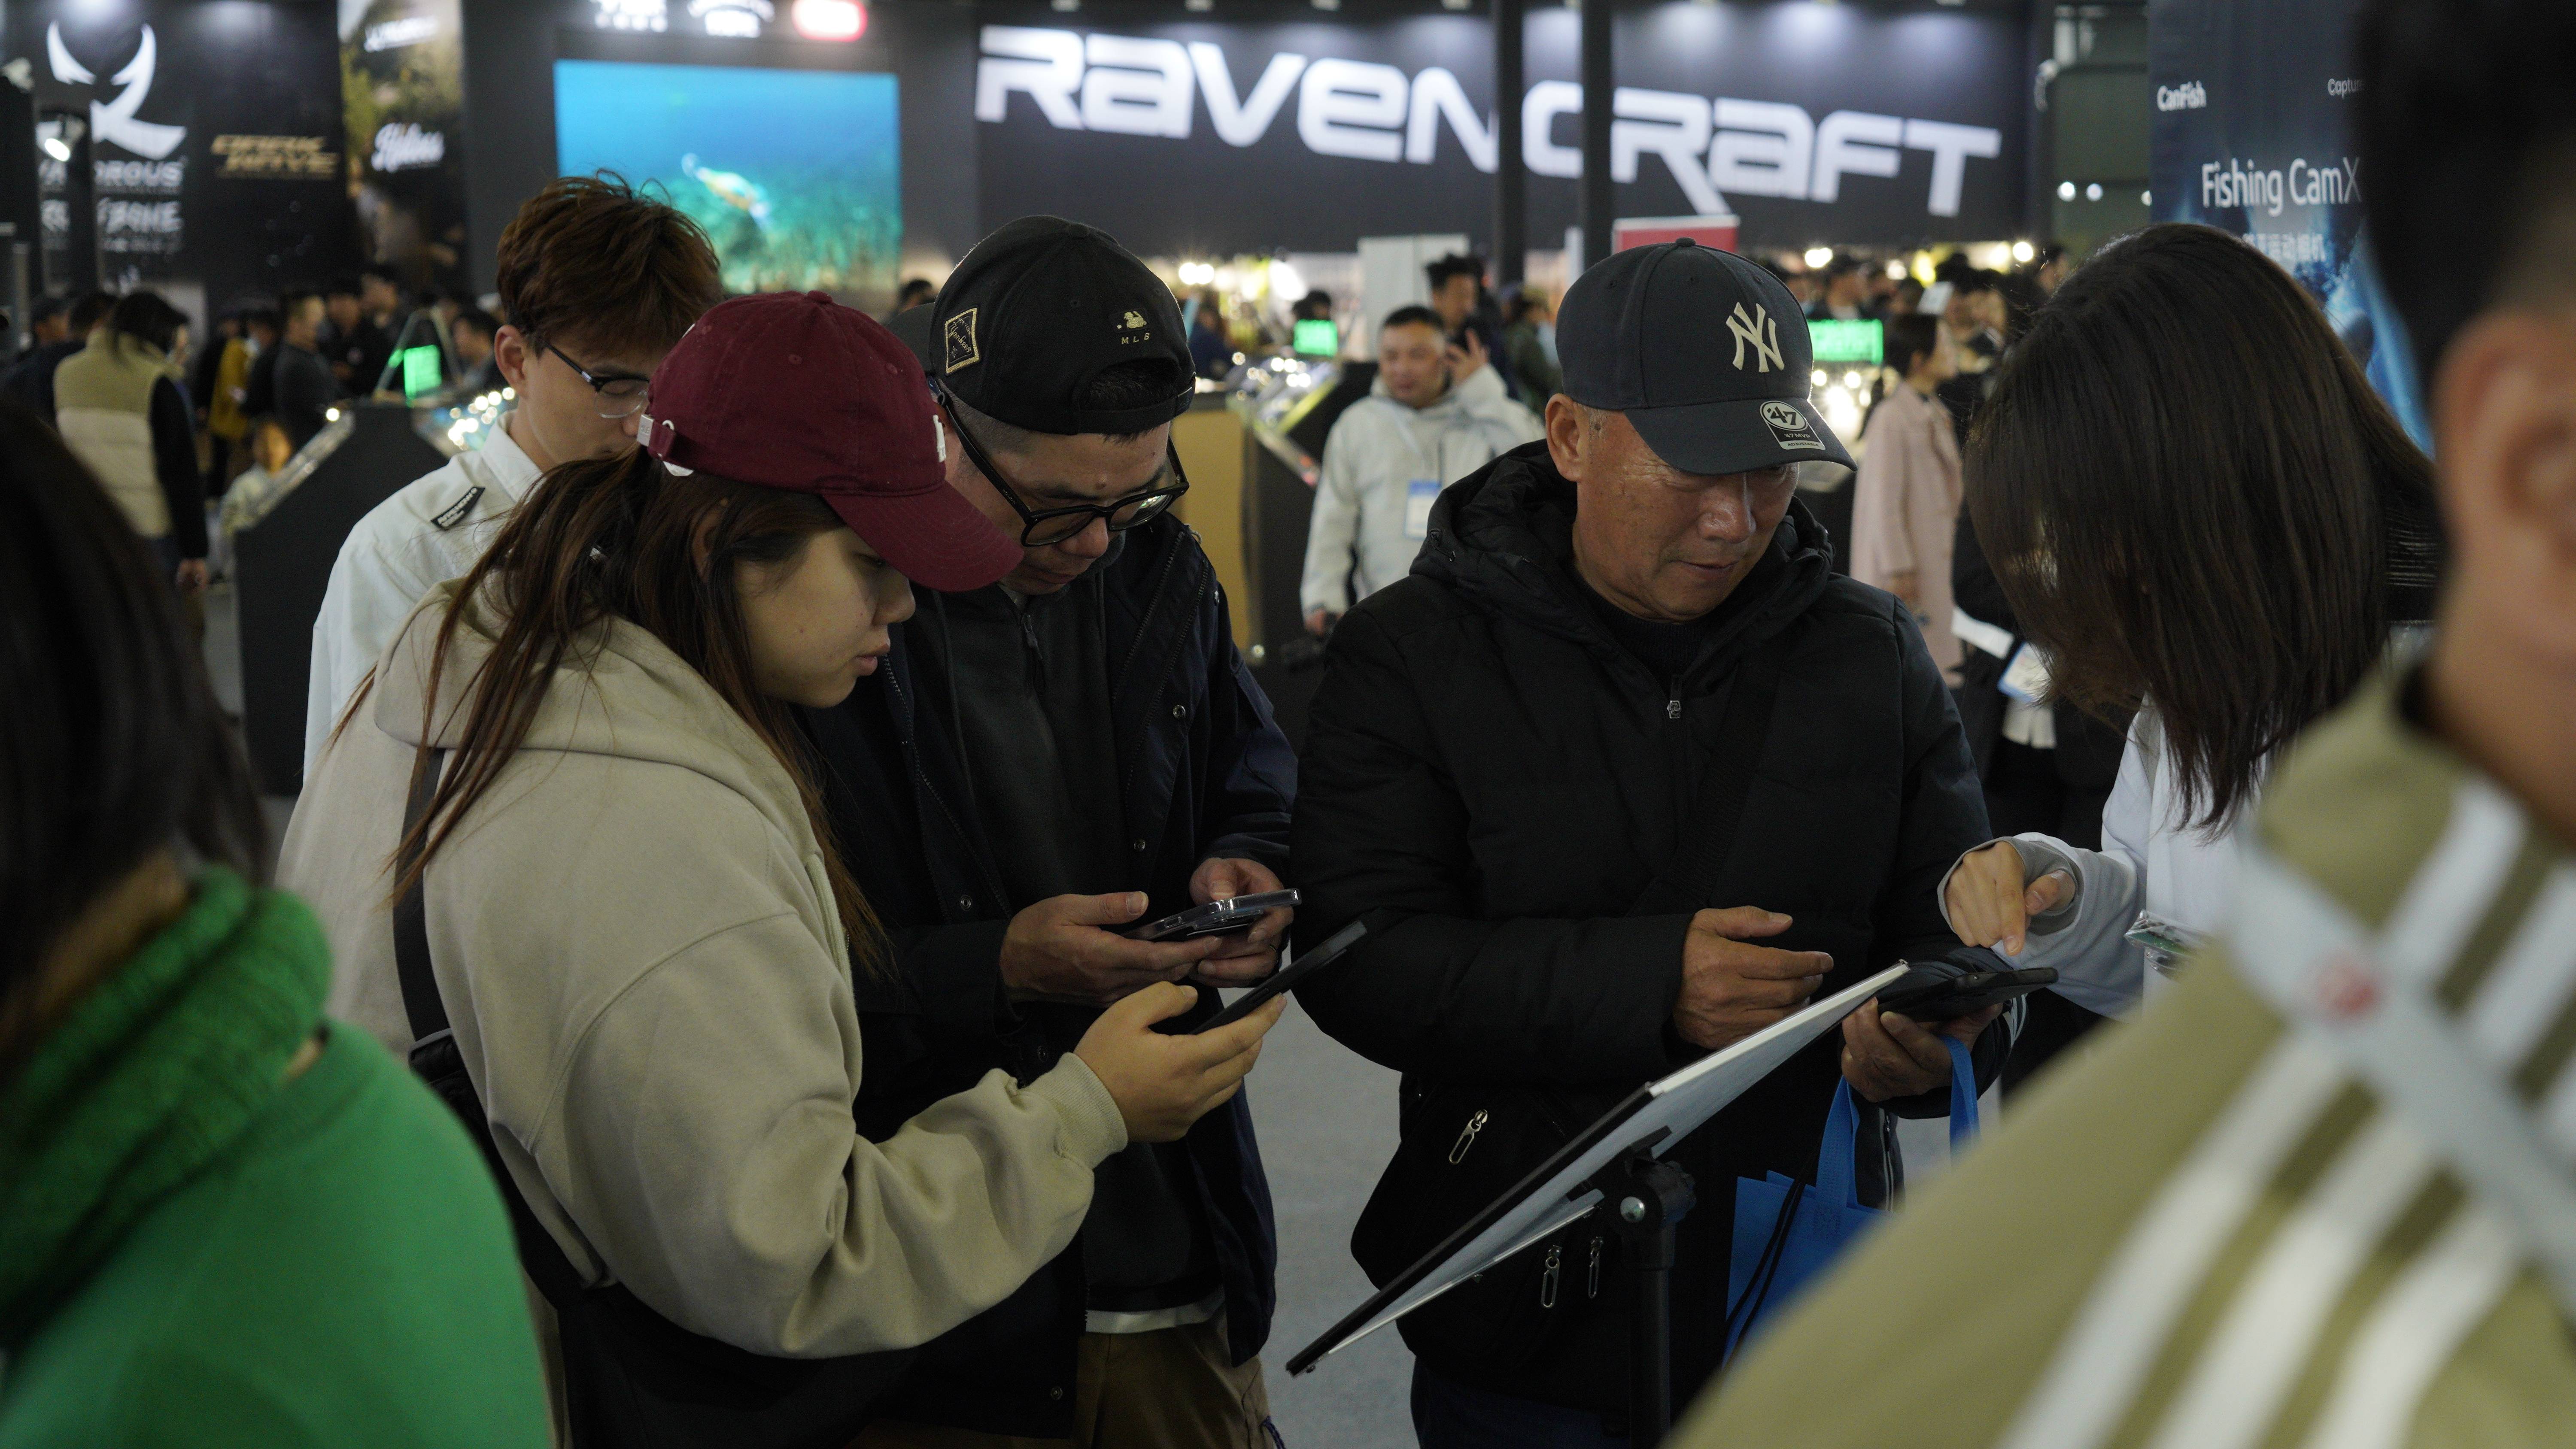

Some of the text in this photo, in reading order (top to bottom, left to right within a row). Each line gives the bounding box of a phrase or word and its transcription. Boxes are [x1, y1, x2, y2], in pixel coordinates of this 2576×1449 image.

[2157, 80, 2206, 112] CanFish
[2327, 77, 2363, 99] Captur
[2202, 158, 2283, 217] Fishing
[1725, 302, 1785, 373] NY
